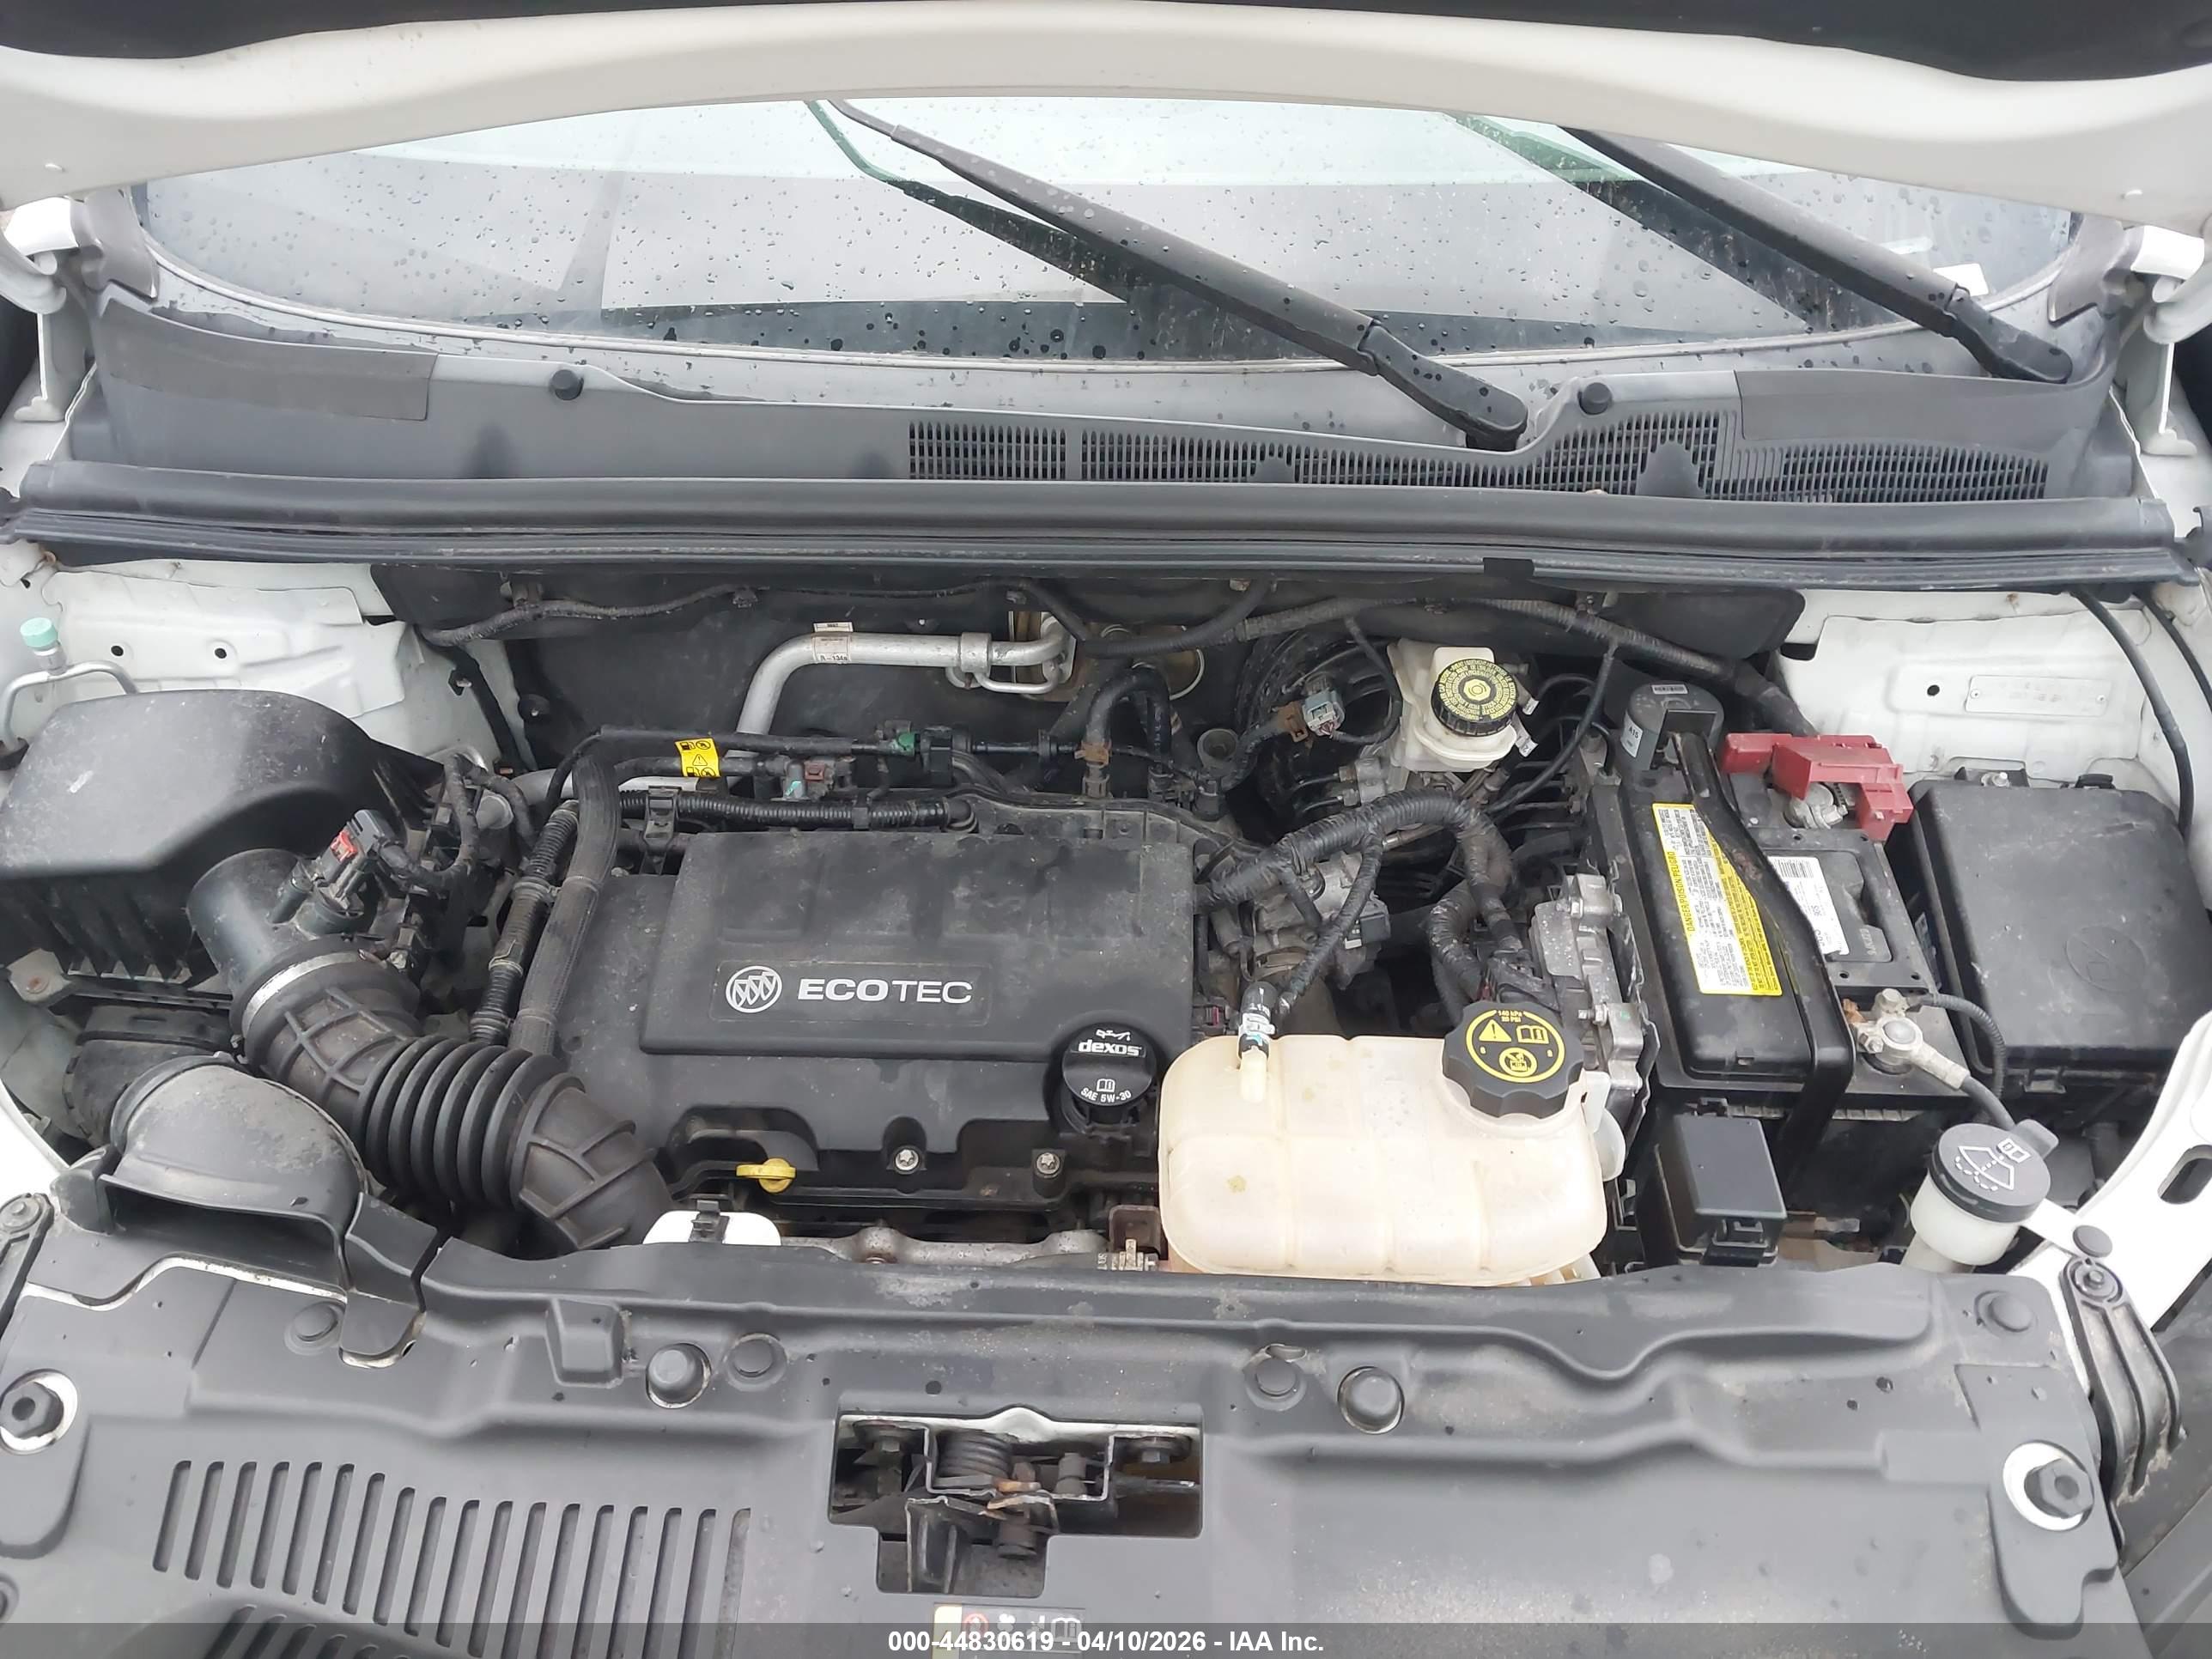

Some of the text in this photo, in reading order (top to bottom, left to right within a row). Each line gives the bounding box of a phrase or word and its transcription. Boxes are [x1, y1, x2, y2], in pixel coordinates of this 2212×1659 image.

[798, 978, 973, 1004] ECOTEC
[1079, 1039, 1142, 1056] dexos
[1080, 1087, 1132, 1103] SAE 5W-30
